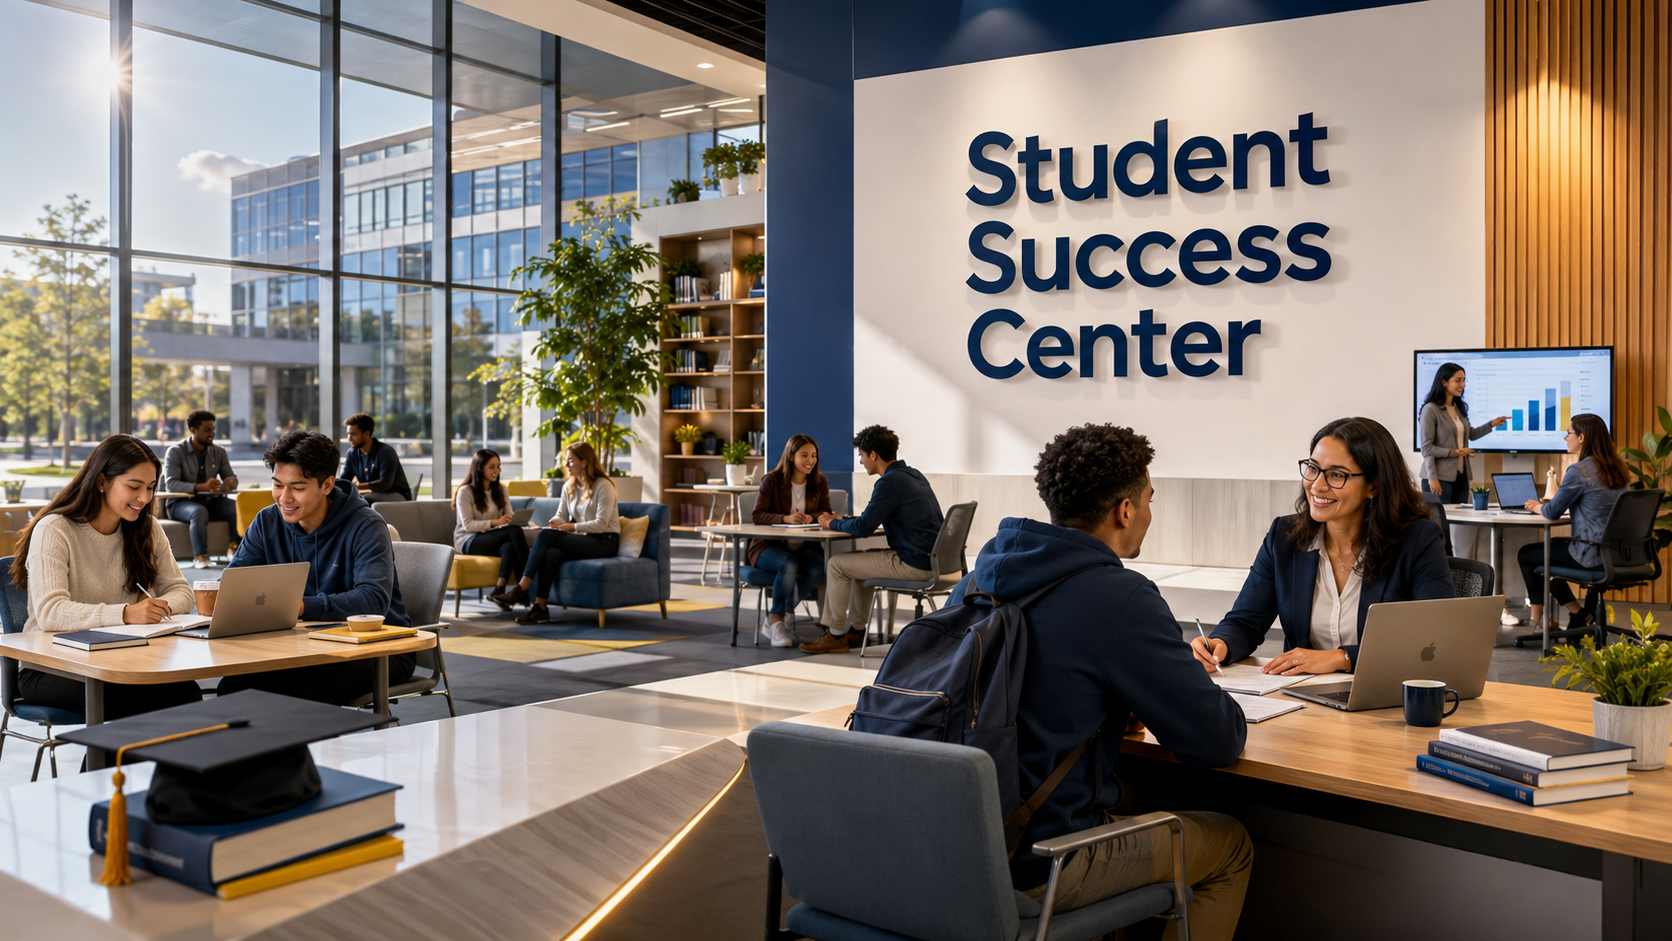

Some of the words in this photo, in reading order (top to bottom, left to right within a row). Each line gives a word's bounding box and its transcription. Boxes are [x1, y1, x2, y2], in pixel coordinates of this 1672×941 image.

[966, 112, 1330, 206] Student
[966, 221, 1331, 294] Success
[968, 309, 1261, 379] Center
